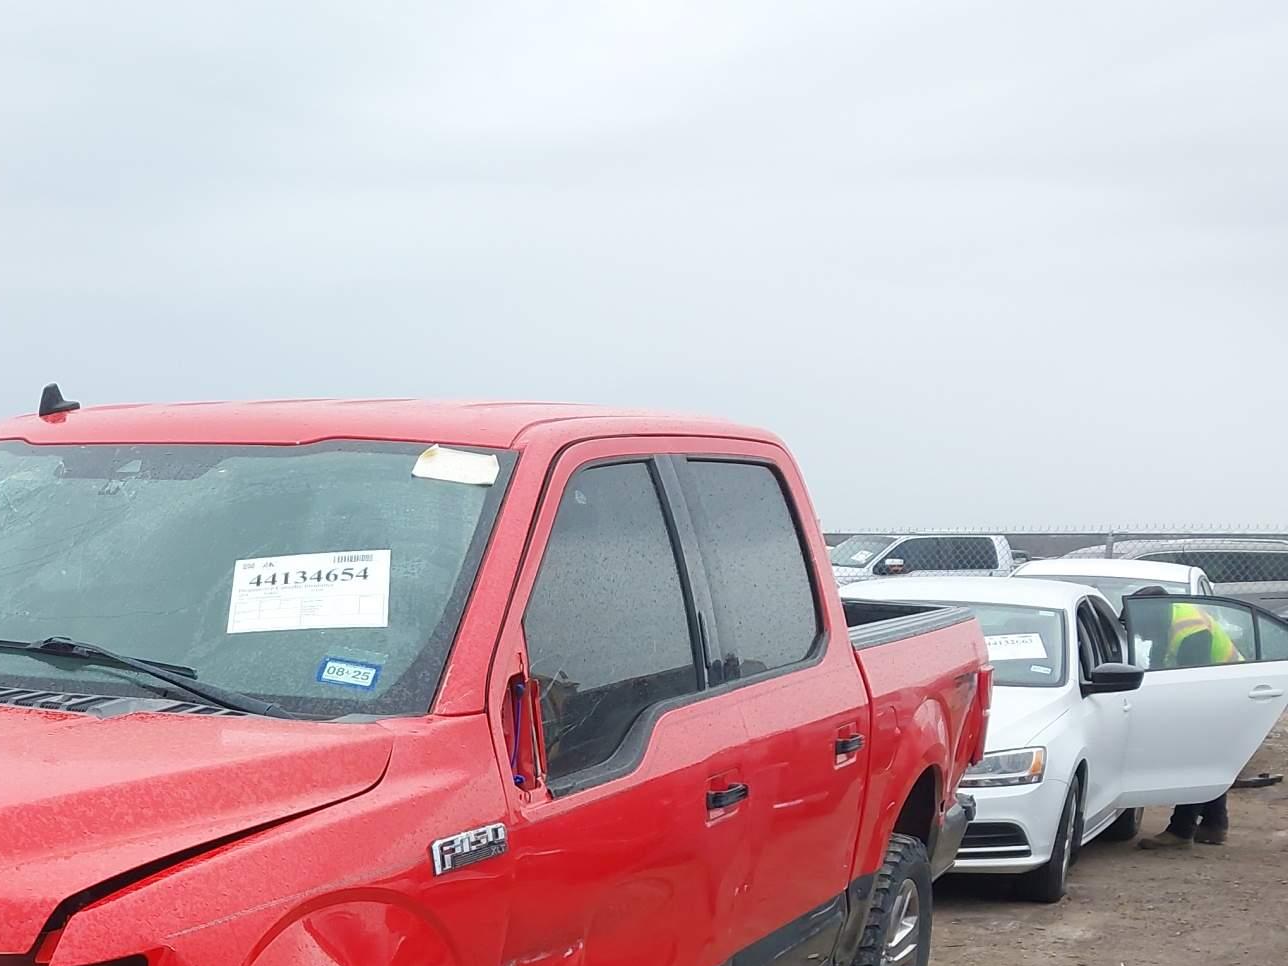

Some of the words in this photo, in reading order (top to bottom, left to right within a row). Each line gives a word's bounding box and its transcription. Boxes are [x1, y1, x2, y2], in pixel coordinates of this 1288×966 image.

[249, 567, 369, 587] 44134654
[326, 665, 345, 677] 08
[352, 670, 371, 681] 25
[491, 843, 506, 855] XLT
